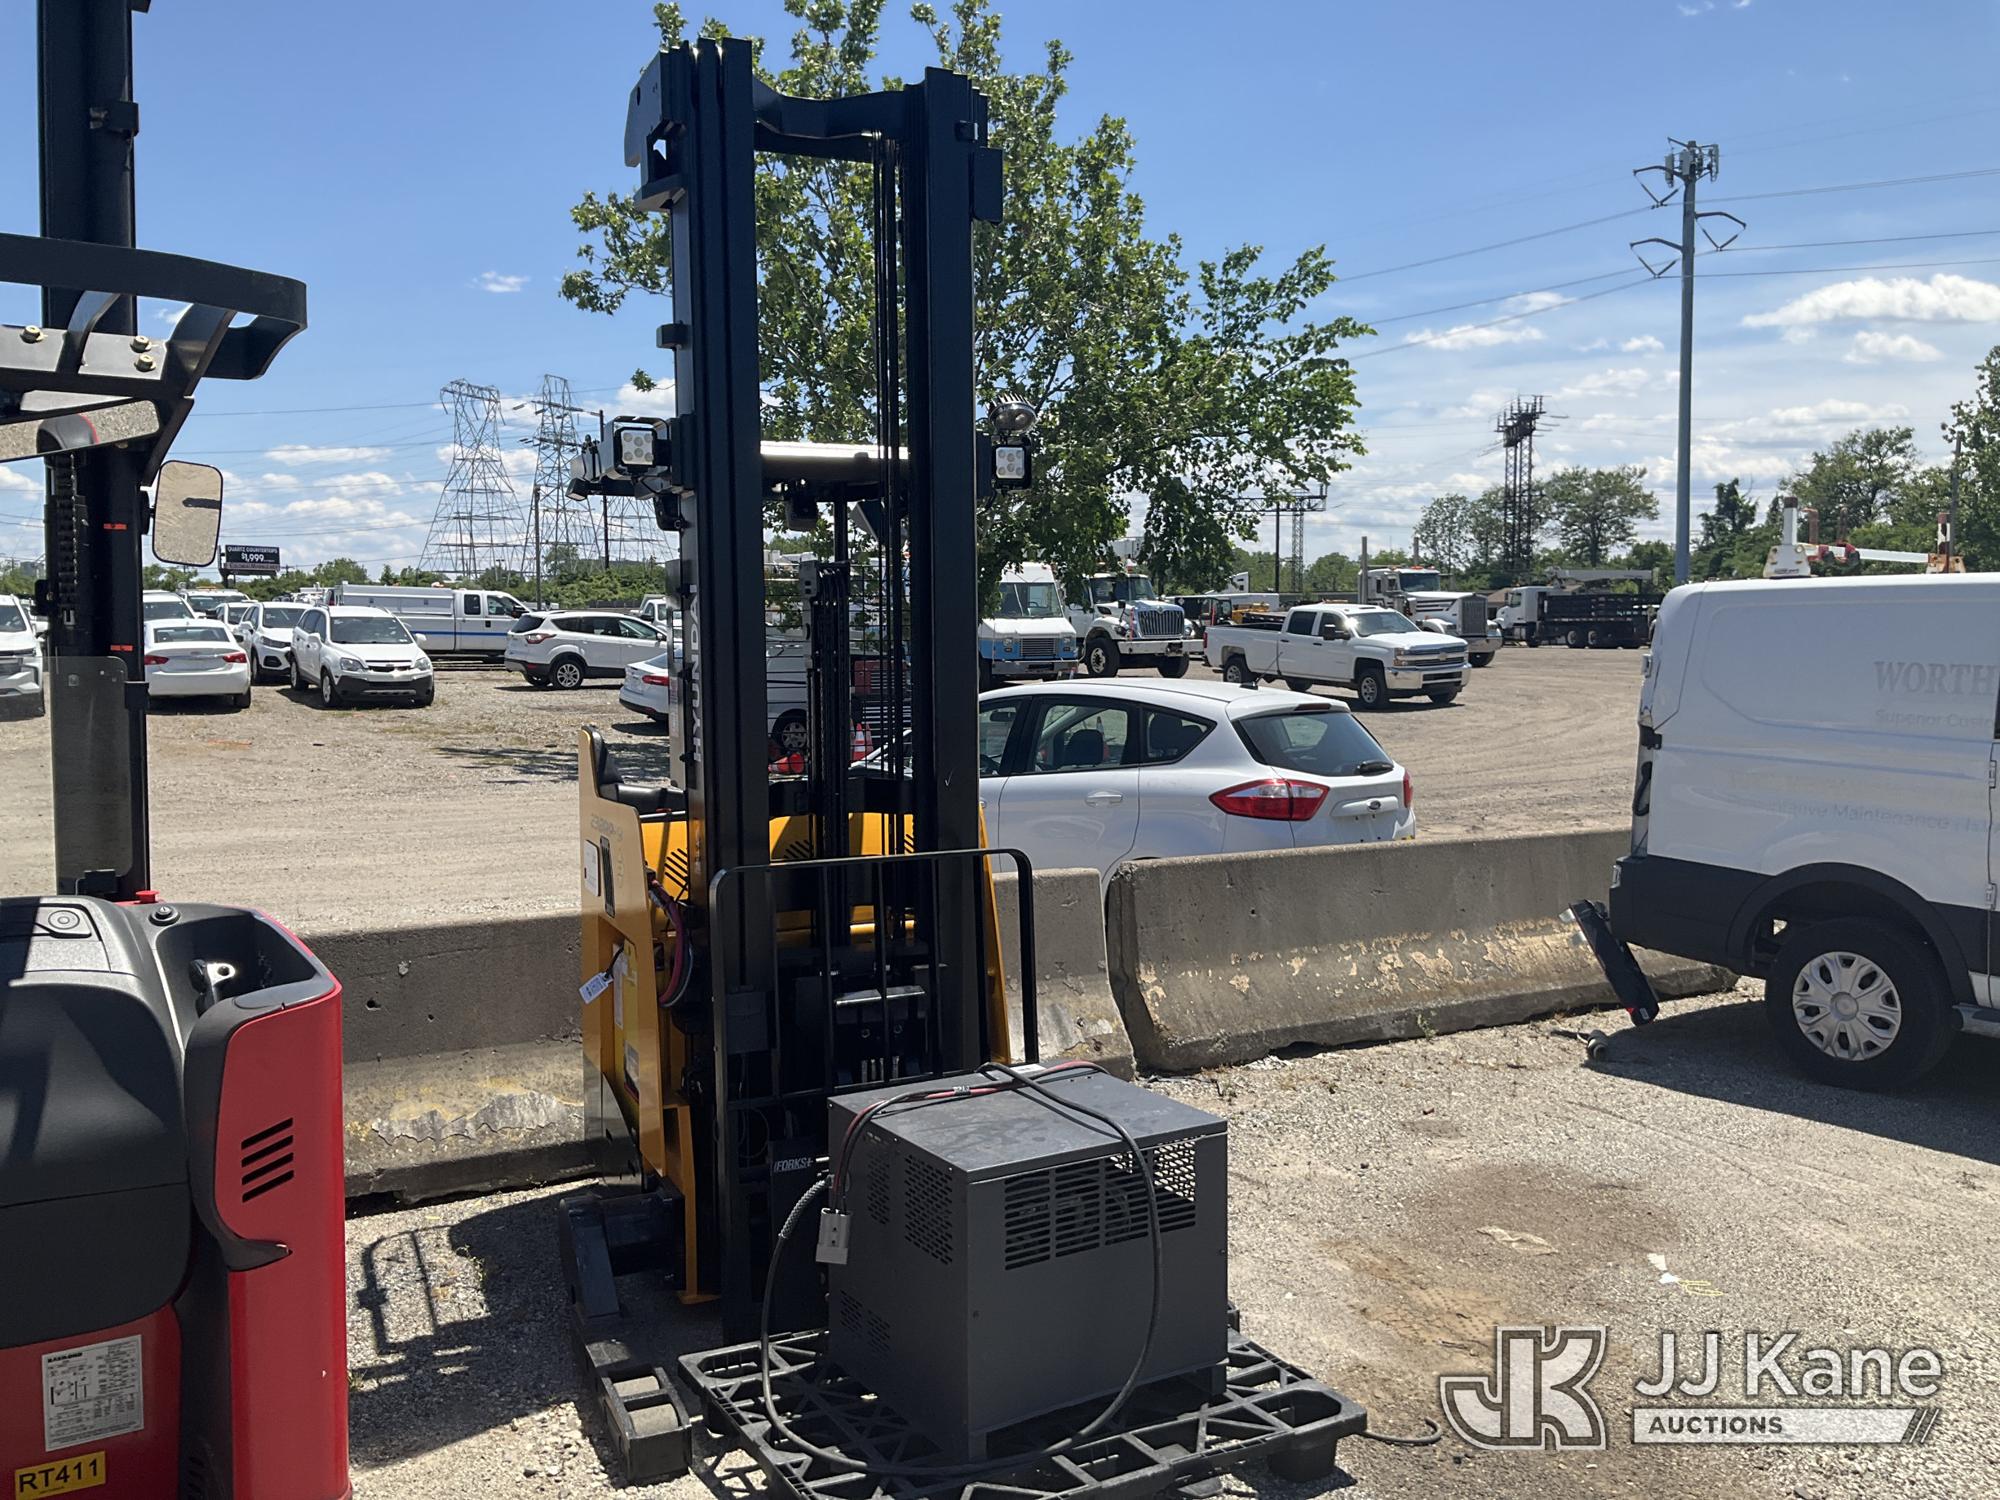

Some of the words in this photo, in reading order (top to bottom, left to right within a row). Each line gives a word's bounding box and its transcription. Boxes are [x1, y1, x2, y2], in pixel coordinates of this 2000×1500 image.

[241, 552, 265, 562] $1,999
[689, 584, 702, 762] HYUNDAI
[1873, 661, 1996, 696] WORTH
[1875, 708, 1942, 728] Superior
[1833, 802, 1951, 830] Maintenance
[18, 1458, 98, 1493] RT411
